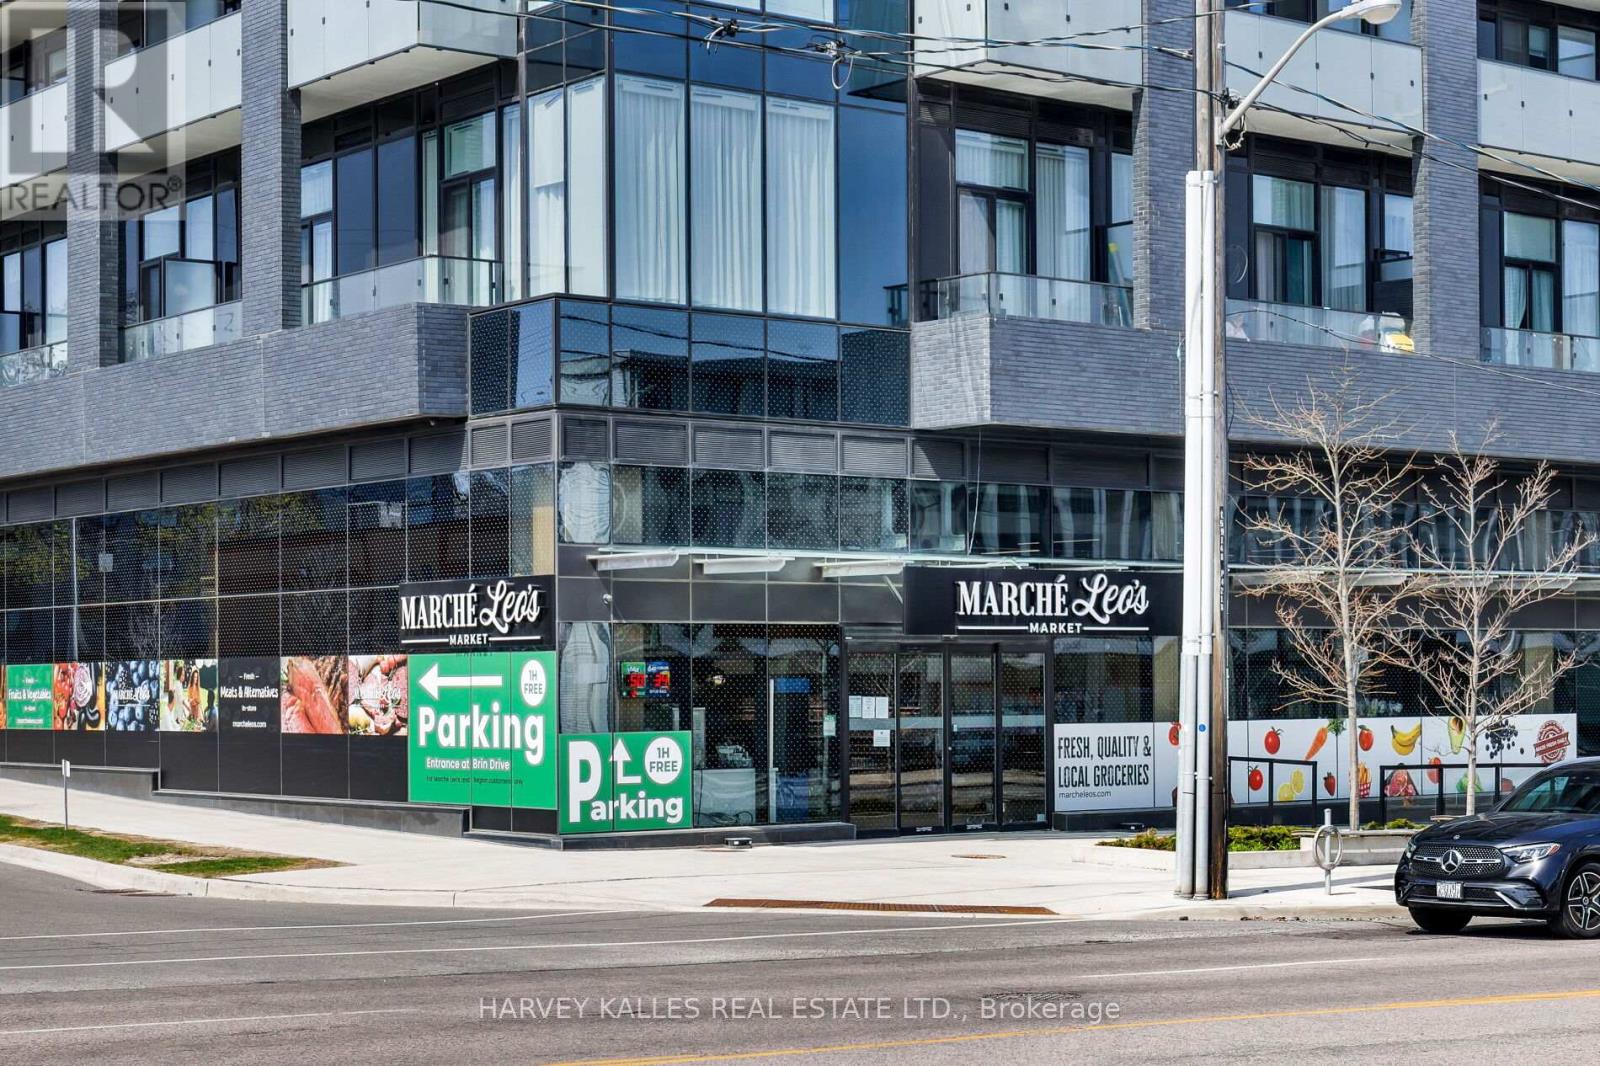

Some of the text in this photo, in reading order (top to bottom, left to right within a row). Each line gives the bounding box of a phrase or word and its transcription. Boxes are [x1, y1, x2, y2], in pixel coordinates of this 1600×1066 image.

[956, 574, 1149, 624] MARCHÉ Leo's
[401, 580, 540, 634] MARCHÉ Leo's
[1029, 622, 1082, 634] MARKET
[449, 633, 488, 646] MARKET
[528, 669, 538, 681] 1H
[220, 686, 279, 698] Meats & Alternatives
[523, 683, 543, 695] FREE
[418, 702, 544, 766] Parking
[656, 747, 669, 758] 1H
[1058, 735, 1151, 760] FRESH, QUALITY &
[426, 758, 510, 770] Entrance at Brin Drive
[649, 761, 678, 772] FREE
[1058, 764, 1149, 788] LOCAL GROCERIES
[1058, 790, 1111, 798] marcheleos.com
